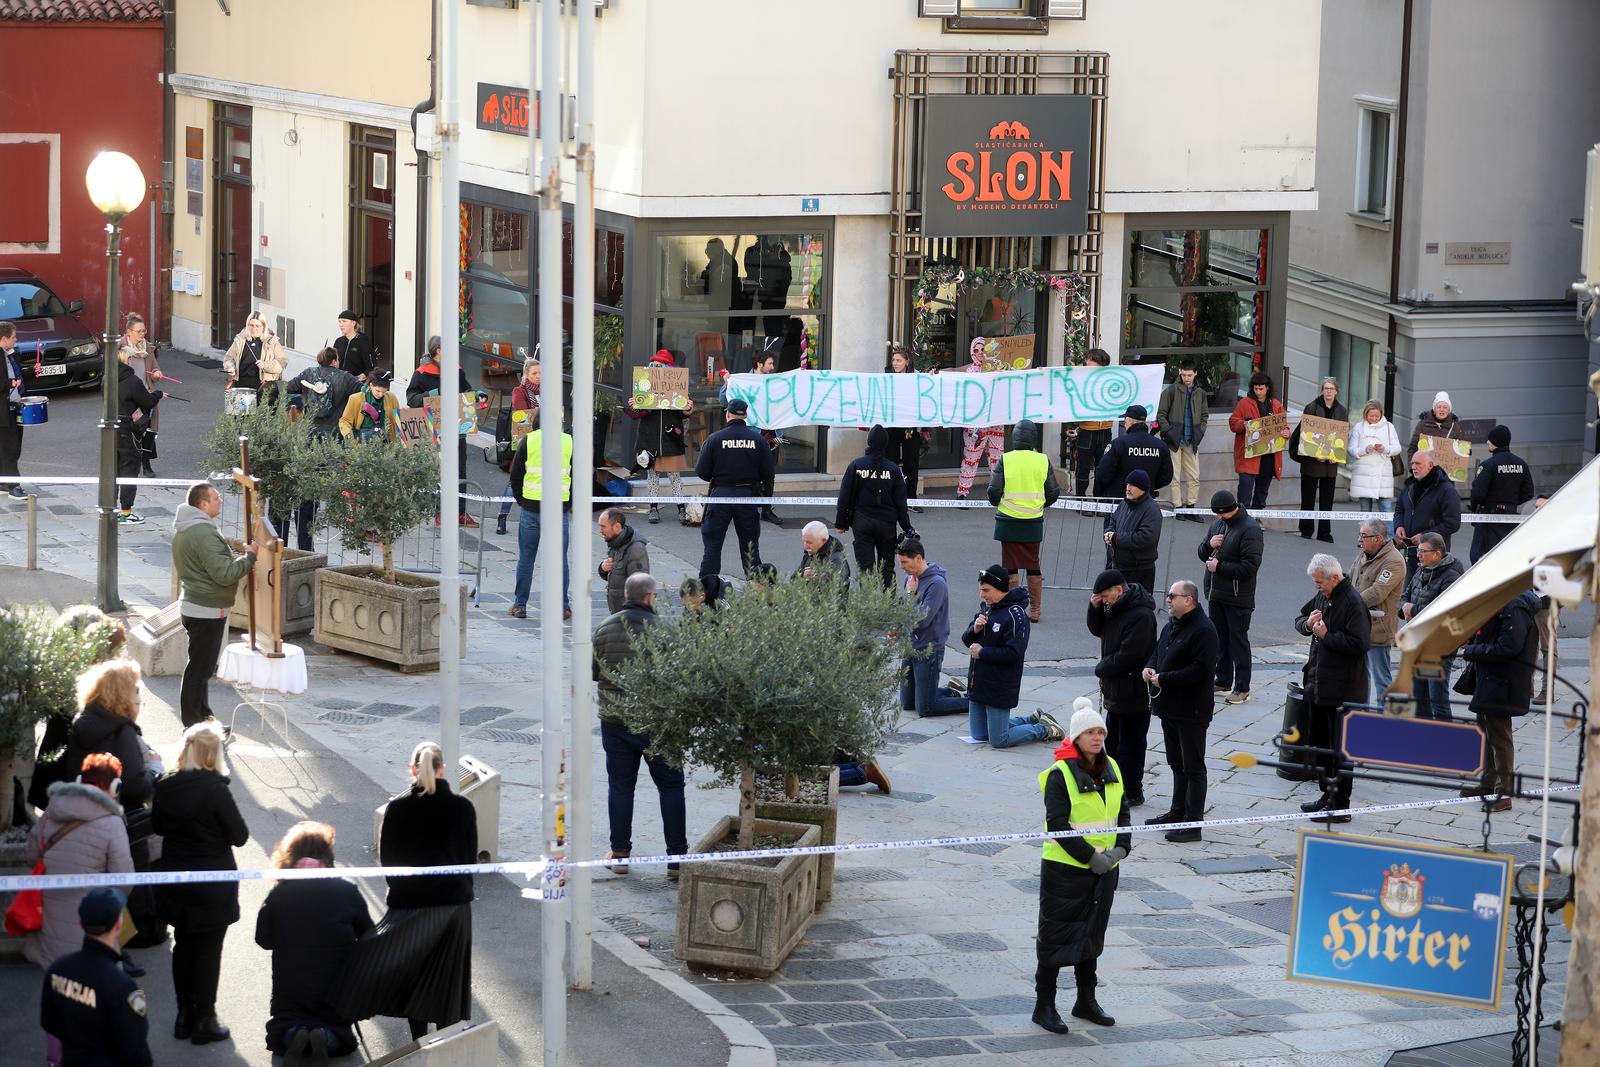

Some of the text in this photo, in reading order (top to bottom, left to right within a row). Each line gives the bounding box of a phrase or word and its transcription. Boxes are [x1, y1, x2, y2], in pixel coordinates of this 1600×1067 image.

[501, 95, 538, 129] SLO
[941, 151, 1074, 201] SLON
[765, 369, 1053, 425] PUŽEVNI BUDITE!
[722, 439, 756, 449] POLICIJA
[1128, 447, 1160, 457] POLICIJA
[1498, 465, 1523, 474] POLICIJA
[1323, 906, 1471, 971] Hirter
[51, 974, 96, 1009] POLICIJA
